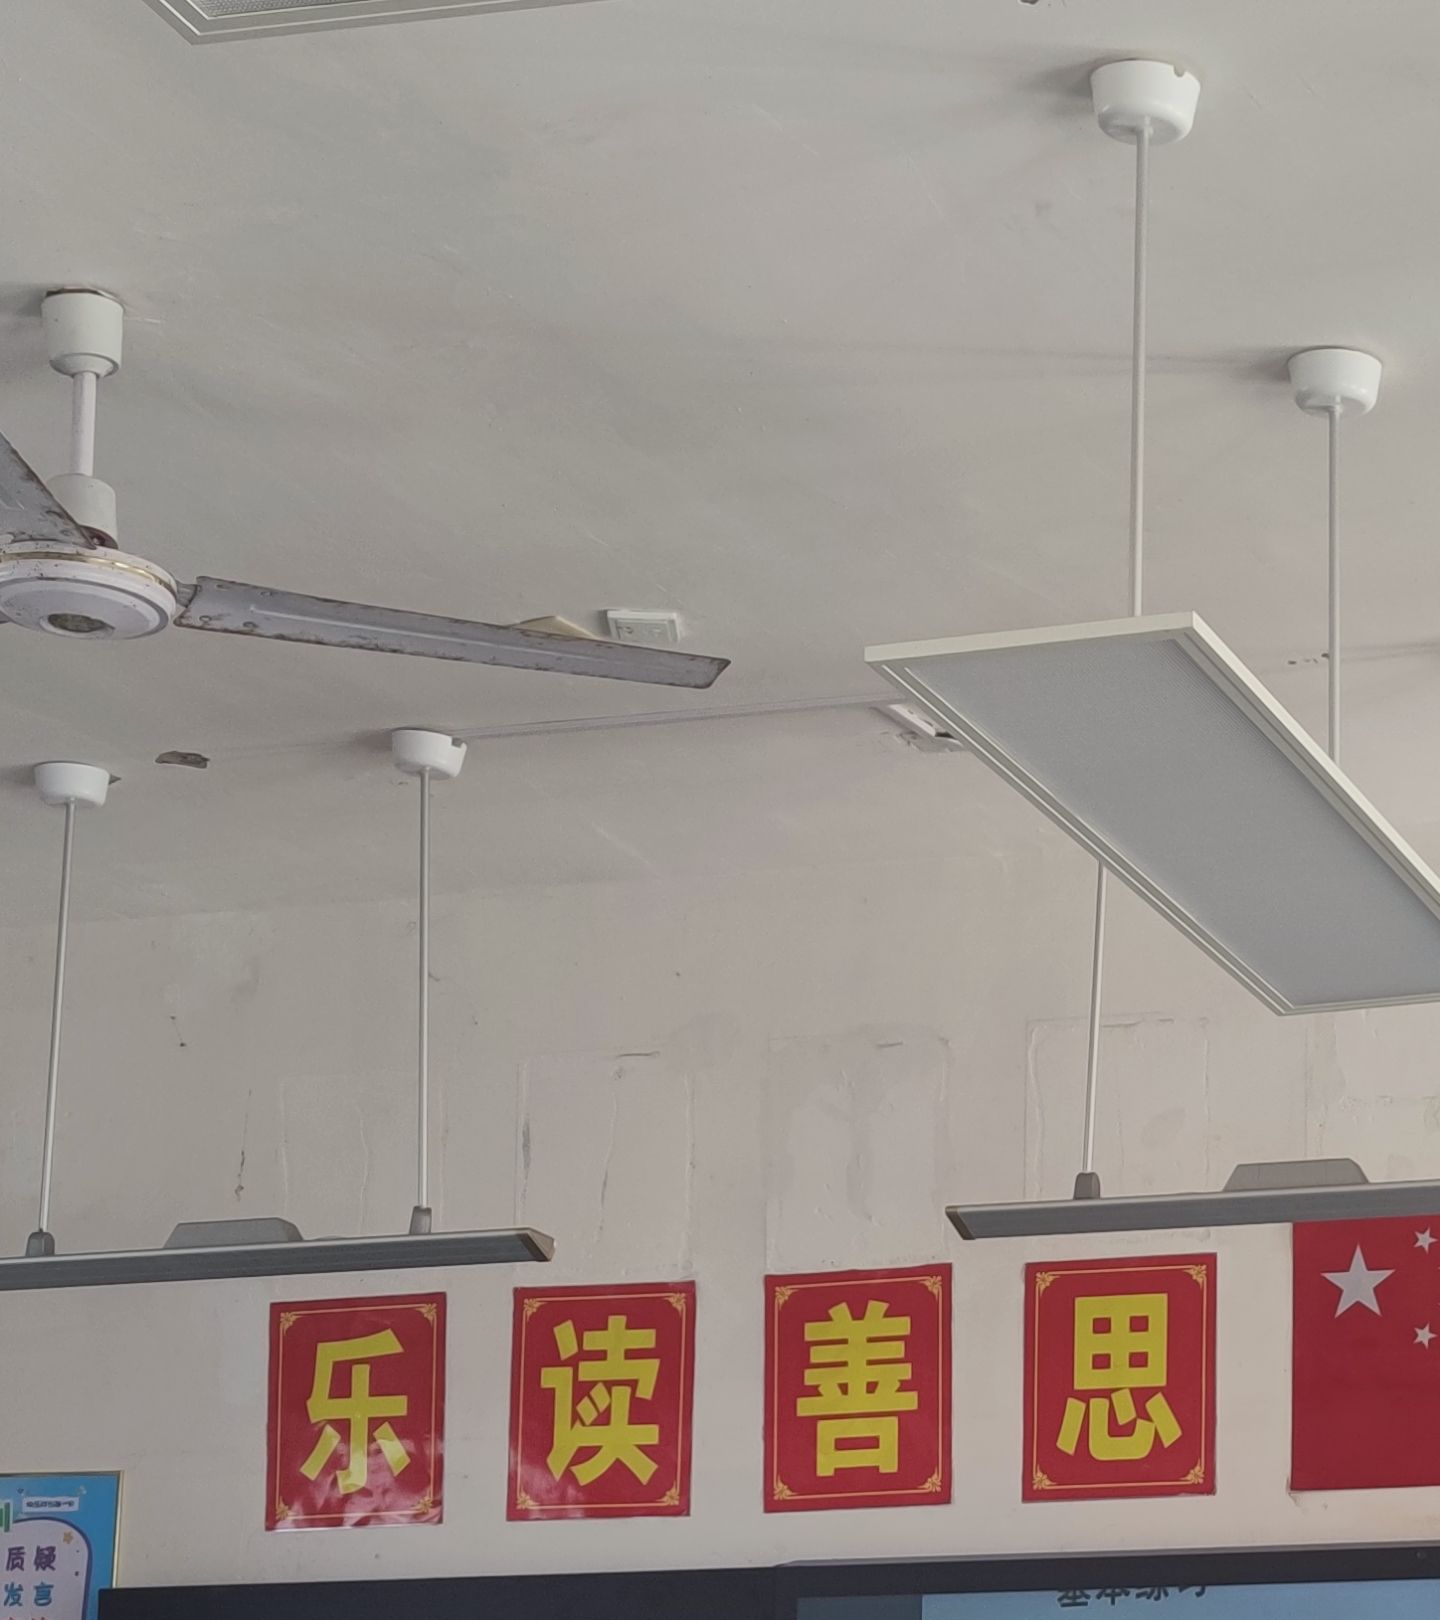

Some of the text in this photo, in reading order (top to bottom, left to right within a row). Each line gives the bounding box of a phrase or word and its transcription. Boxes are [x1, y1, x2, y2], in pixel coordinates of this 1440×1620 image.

[301, 1328, 411, 1494] 乐
[542, 1314, 660, 1486] 读
[796, 1301, 918, 1477] 善
[1056, 1293, 1182, 1460] 思
